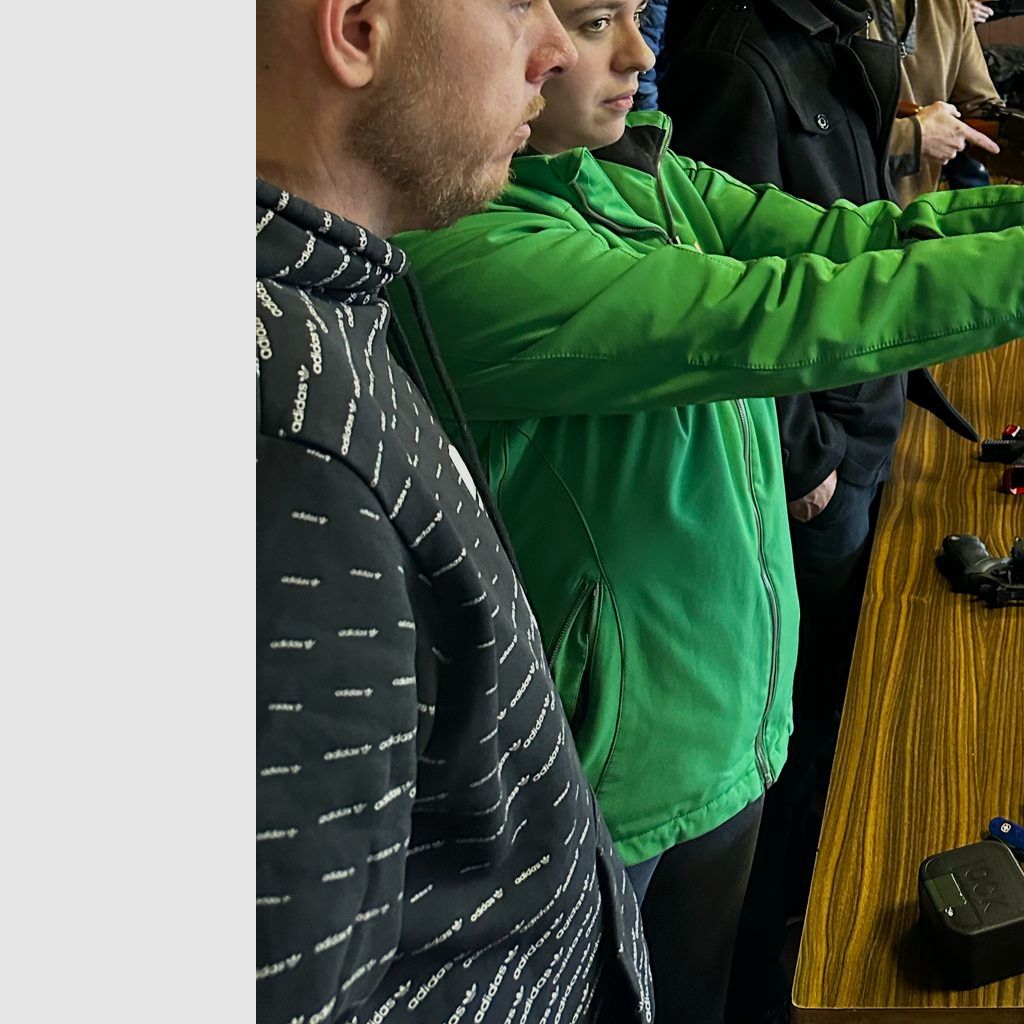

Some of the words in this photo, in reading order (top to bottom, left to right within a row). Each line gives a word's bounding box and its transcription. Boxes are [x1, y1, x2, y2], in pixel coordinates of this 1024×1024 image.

[295, 236, 316, 269] adidas
[310, 332, 323, 375] adidas
[291, 383, 308, 433] adidas
[341, 414, 355, 456] adidas
[510, 674, 532, 708] adidas
[523, 708, 547, 749] adidas
[324, 749, 360, 761] adidas
[533, 745, 560, 782] adidas
[515, 863, 542, 885] adidas
[470, 897, 495, 923] adidas
[556, 892, 585, 939] adidas
[513, 931, 551, 980] adidas
[552, 928, 584, 985] adidas
[408, 962, 453, 1011] adidas
[474, 965, 508, 1024] adidas
[520, 968, 552, 1024] adidas
[554, 965, 582, 1024] adidas
